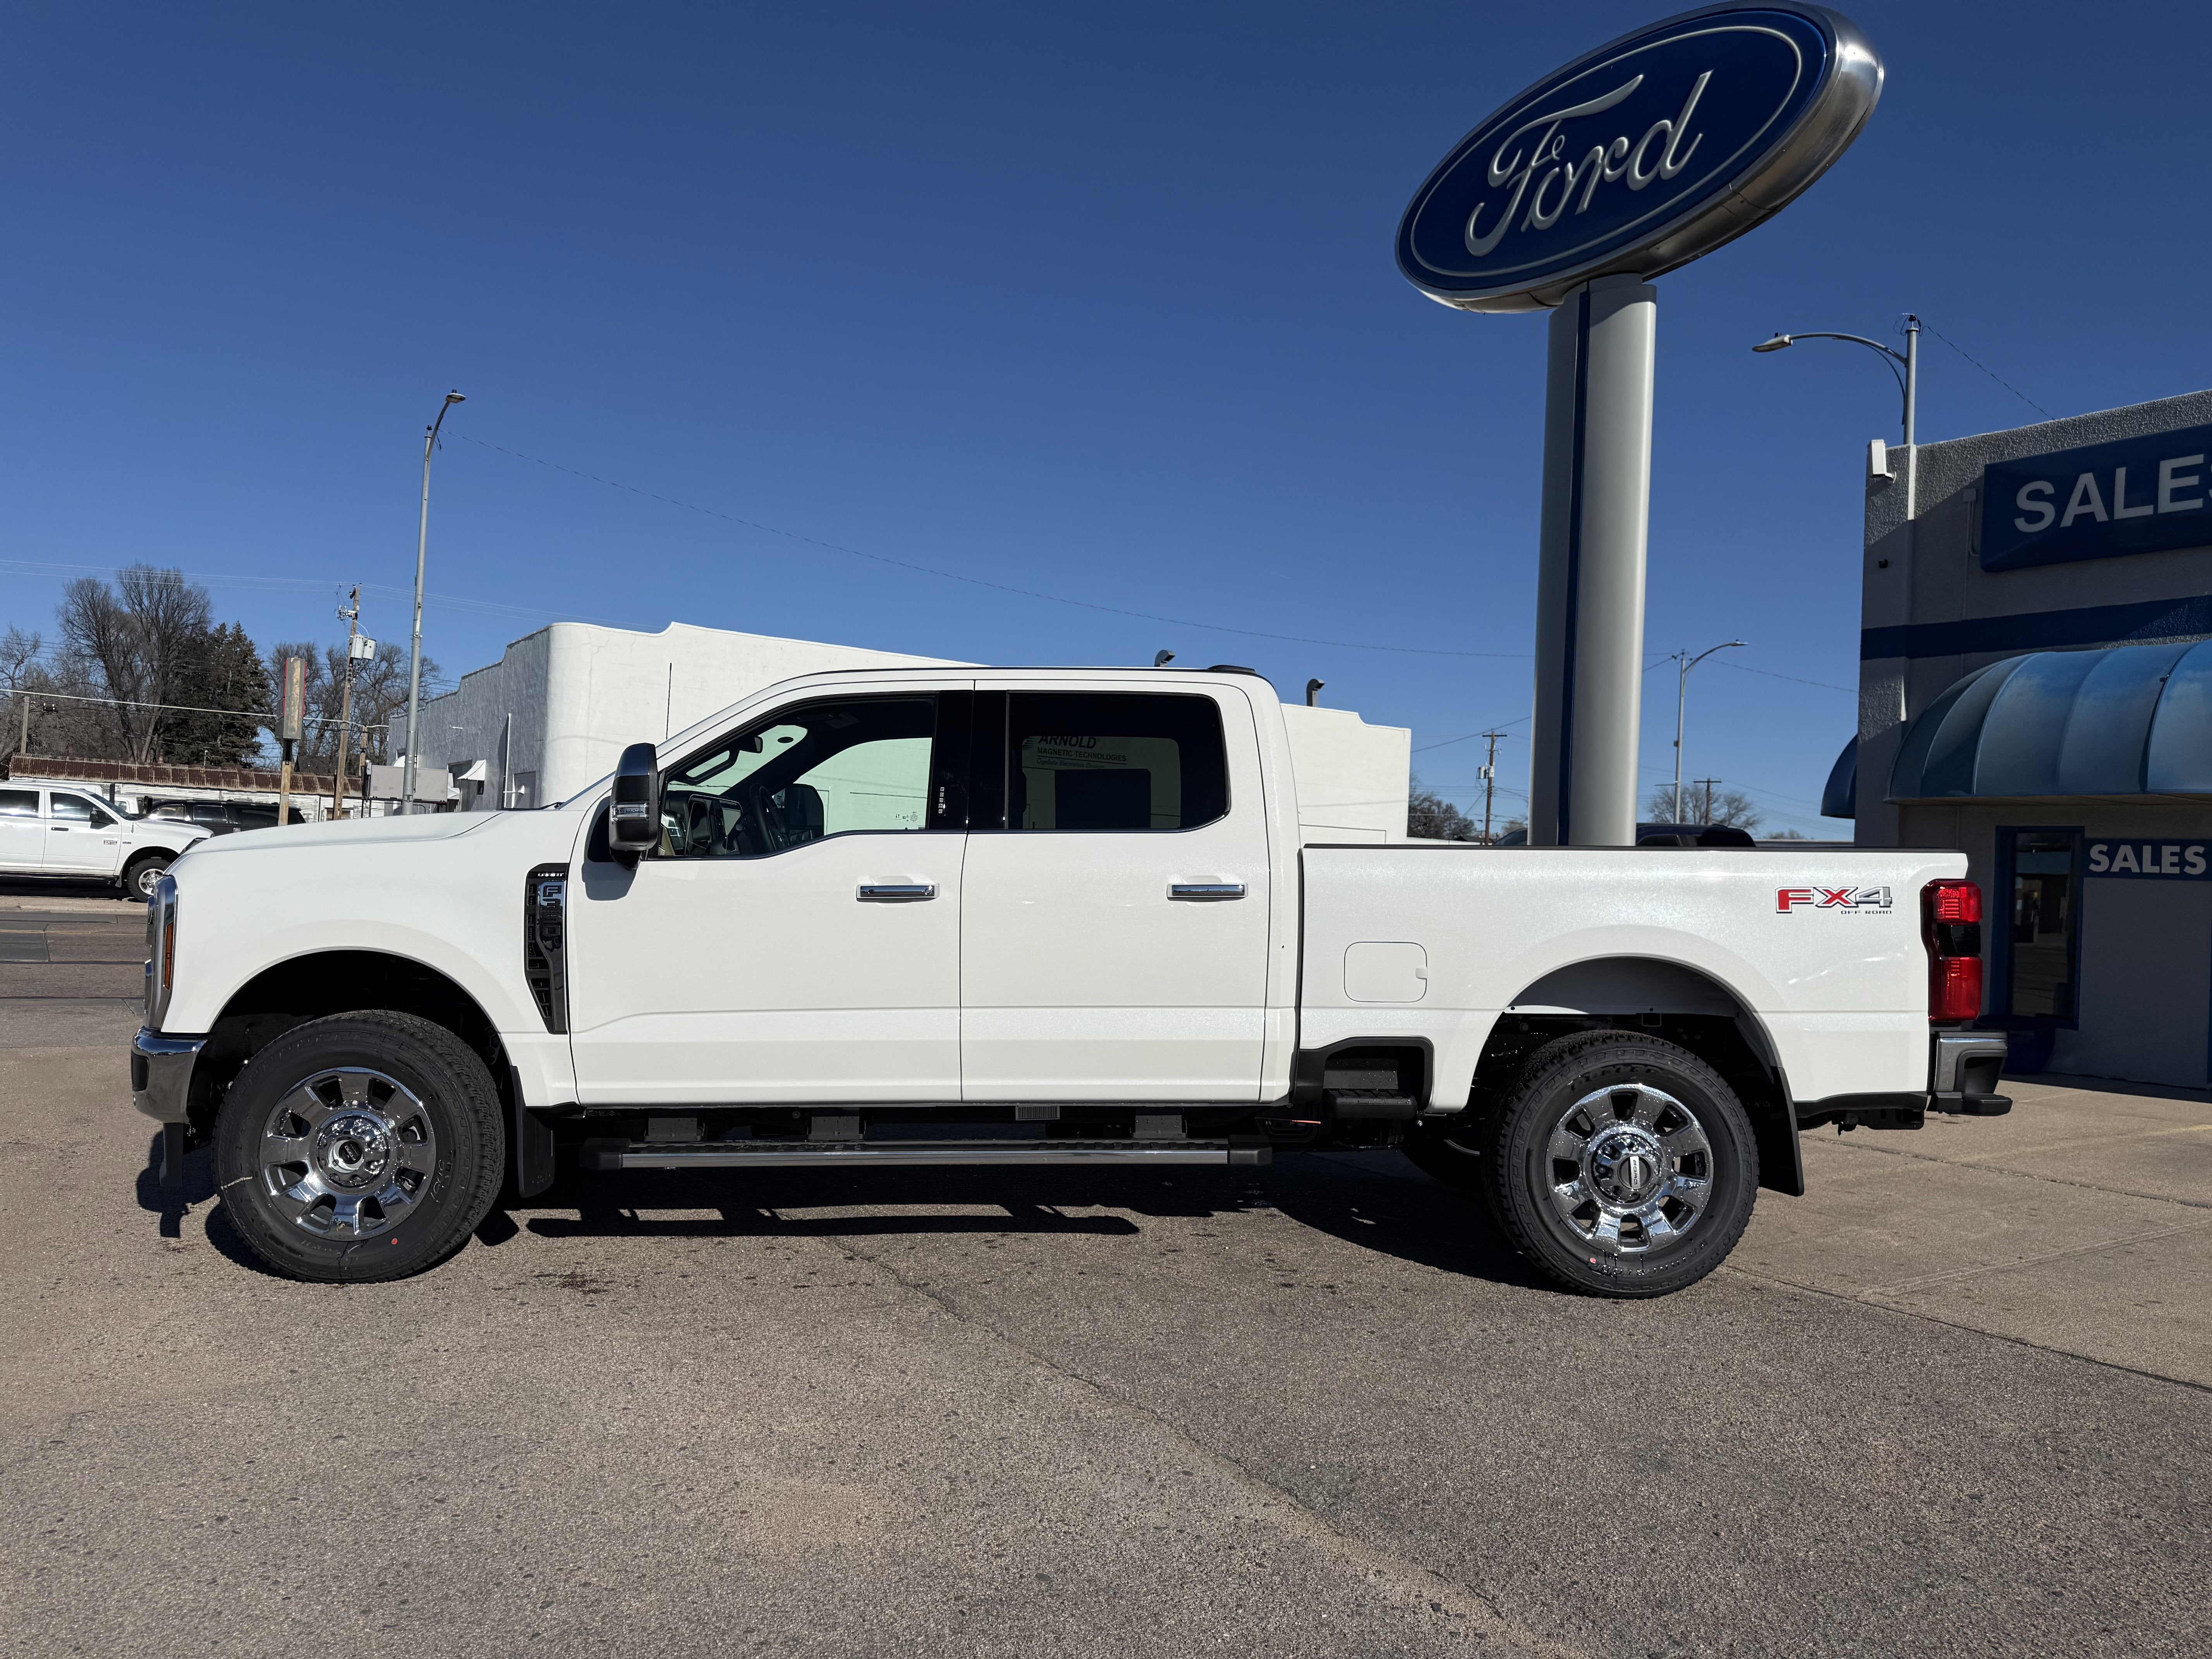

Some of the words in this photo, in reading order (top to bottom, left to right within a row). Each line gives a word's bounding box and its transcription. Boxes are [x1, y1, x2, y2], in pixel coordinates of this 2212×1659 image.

[1464, 68, 1714, 257] Ford
[2014, 453, 2212, 532] SALE
[1037, 747, 1072, 756] MAGNETIC
[1075, 751, 1127, 761] TECHNOLOGIES
[1038, 736, 1096, 748] ARNOLD
[2088, 843, 2207, 875] SALES
[1775, 886, 1893, 914] FX4
